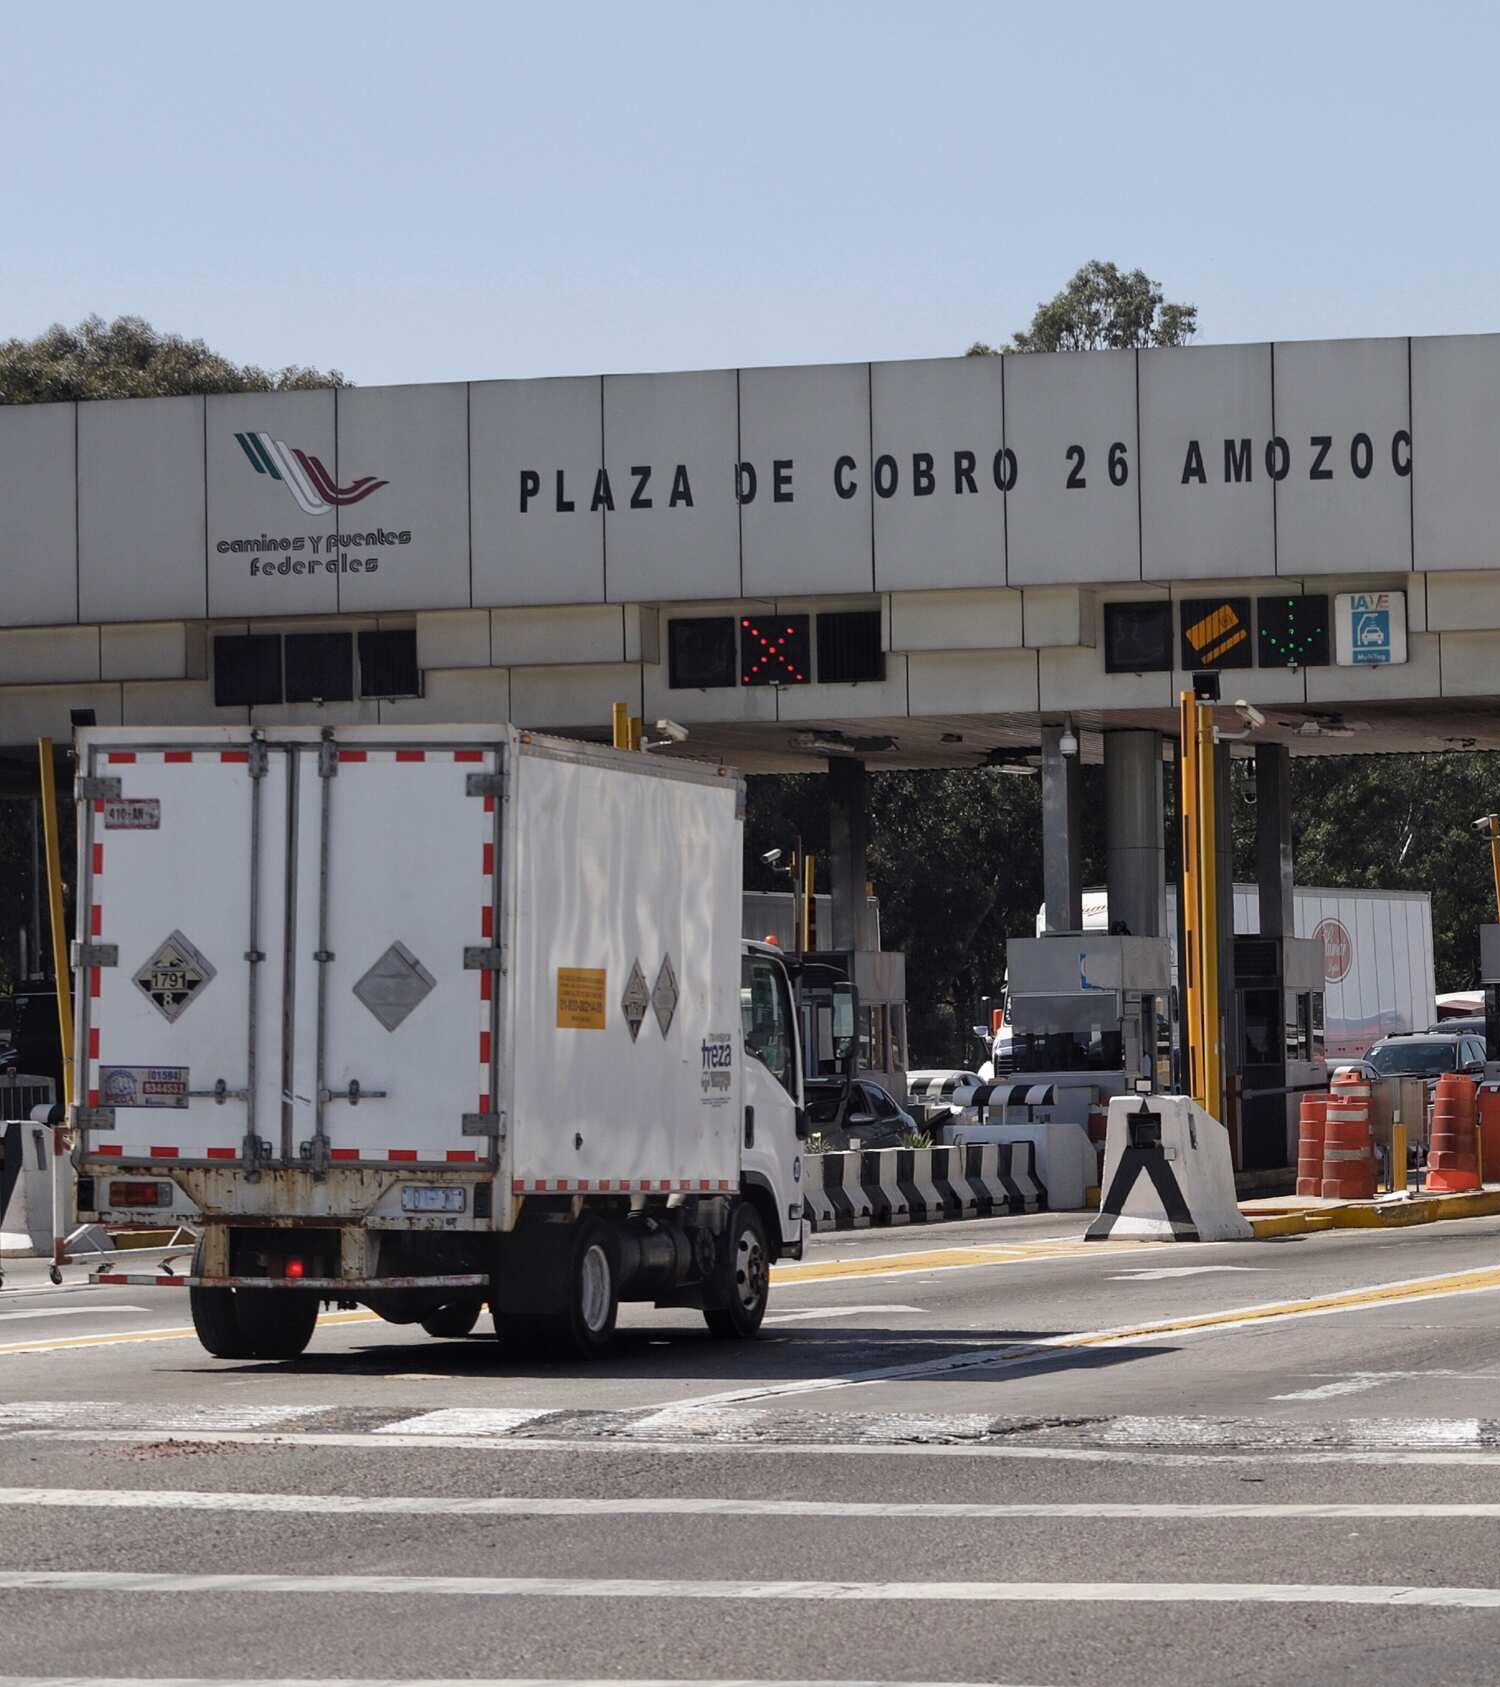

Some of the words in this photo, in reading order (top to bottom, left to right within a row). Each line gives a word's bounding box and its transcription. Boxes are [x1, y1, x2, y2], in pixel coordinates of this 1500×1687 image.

[519, 464, 695, 514] PLAZA
[734, 459, 794, 506] DE
[833, 447, 1019, 500] COBRO
[1065, 441, 1129, 490] 26
[1180, 429, 1412, 485] AMOZOC
[216, 533, 305, 554] caminos
[326, 527, 412, 553] puentes
[250, 552, 379, 577] federales
[1350, 594, 1389, 610] IAVE
[152, 972, 186, 988] 1791
[162, 992, 173, 1008] 8
